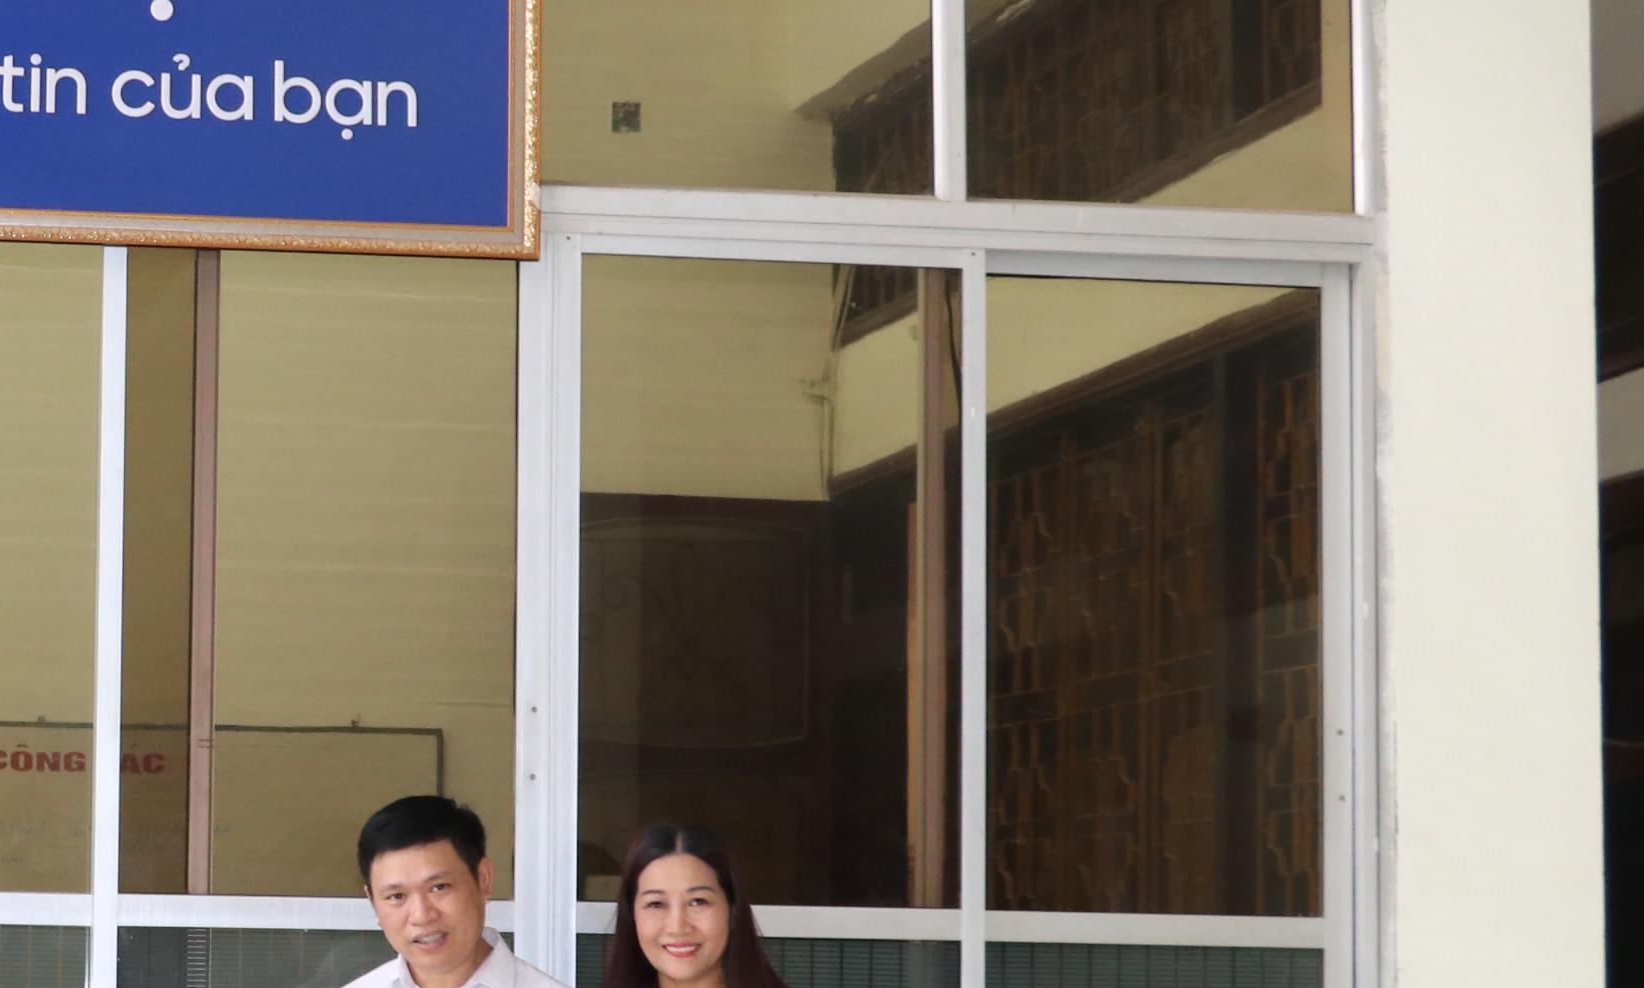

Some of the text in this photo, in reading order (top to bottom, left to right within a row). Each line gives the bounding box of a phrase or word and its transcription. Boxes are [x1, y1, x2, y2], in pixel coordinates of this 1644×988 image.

[111, 53, 254, 121] của
[274, 59, 417, 140] bạn
[119, 744, 166, 774] ÁC
